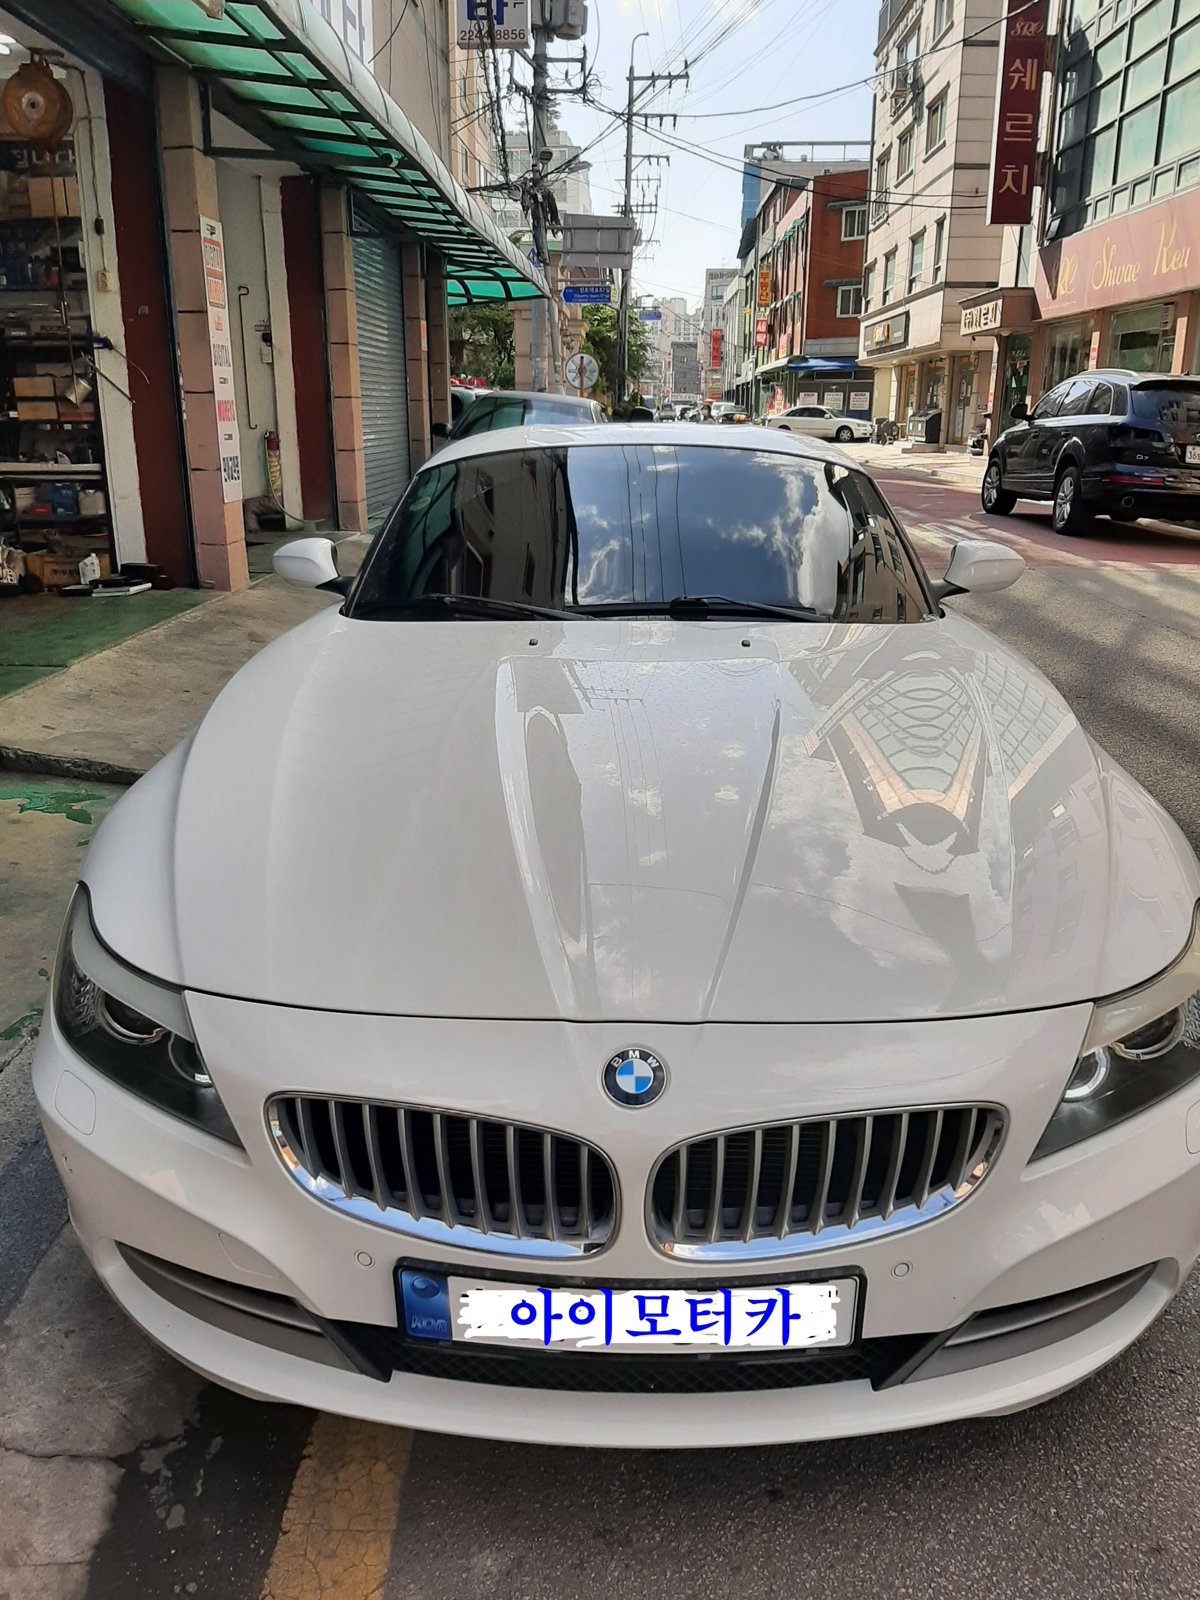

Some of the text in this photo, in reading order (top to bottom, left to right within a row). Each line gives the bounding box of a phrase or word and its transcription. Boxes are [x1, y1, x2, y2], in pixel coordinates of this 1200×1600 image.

[999, 57, 1039, 196] 쉐르치
[1091, 237, 1141, 291] Shwae
[611, 1050, 659, 1067] BMW
[410, 1315, 448, 1331] KOR
